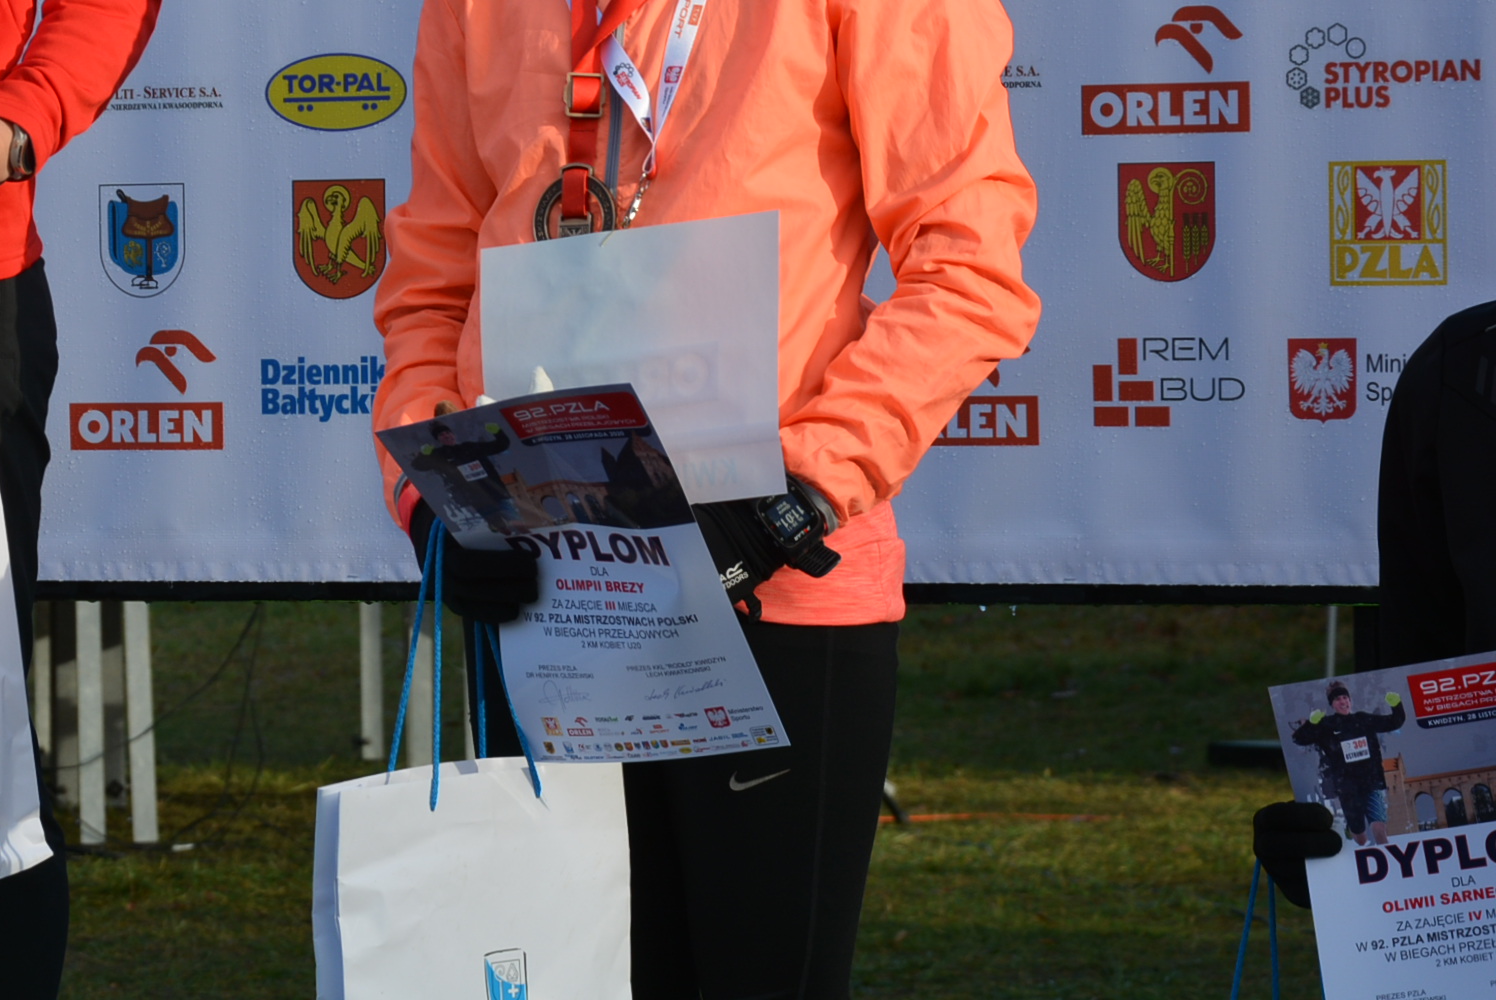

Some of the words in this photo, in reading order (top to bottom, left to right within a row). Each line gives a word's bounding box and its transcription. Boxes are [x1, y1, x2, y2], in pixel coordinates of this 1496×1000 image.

[282, 72, 391, 94] TOR-PAL
[1324, 59, 1481, 84] STYROPIAN
[143, 86, 196, 100] SERVICE
[199, 86, 222, 98] S.A.
[1324, 85, 1391, 109] PLUS
[1089, 89, 1239, 127] ORLEN
[1336, 244, 1441, 280] PZLA
[1142, 337, 1230, 362] REM
[260, 356, 385, 385] Dziennik
[1160, 377, 1246, 401] BUD
[78, 408, 213, 444] ORLEN
[590, 566, 609, 577] DLA
[556, 578, 602, 592] OLIMPII
[605, 580, 645, 594] BREZY
[1451, 875, 1476, 888] DLA
[1382, 895, 1436, 914] OLIWII
[1440, 886, 1496, 905] SARNE
[1396, 921, 1413, 932] ZA
[1415, 912, 1465, 930] ZAJĘCIE
[1468, 910, 1483, 922] IV
[1355, 942, 1368, 953] W
[1370, 939, 1389, 951] 92.
[1391, 934, 1424, 948] PZLA
